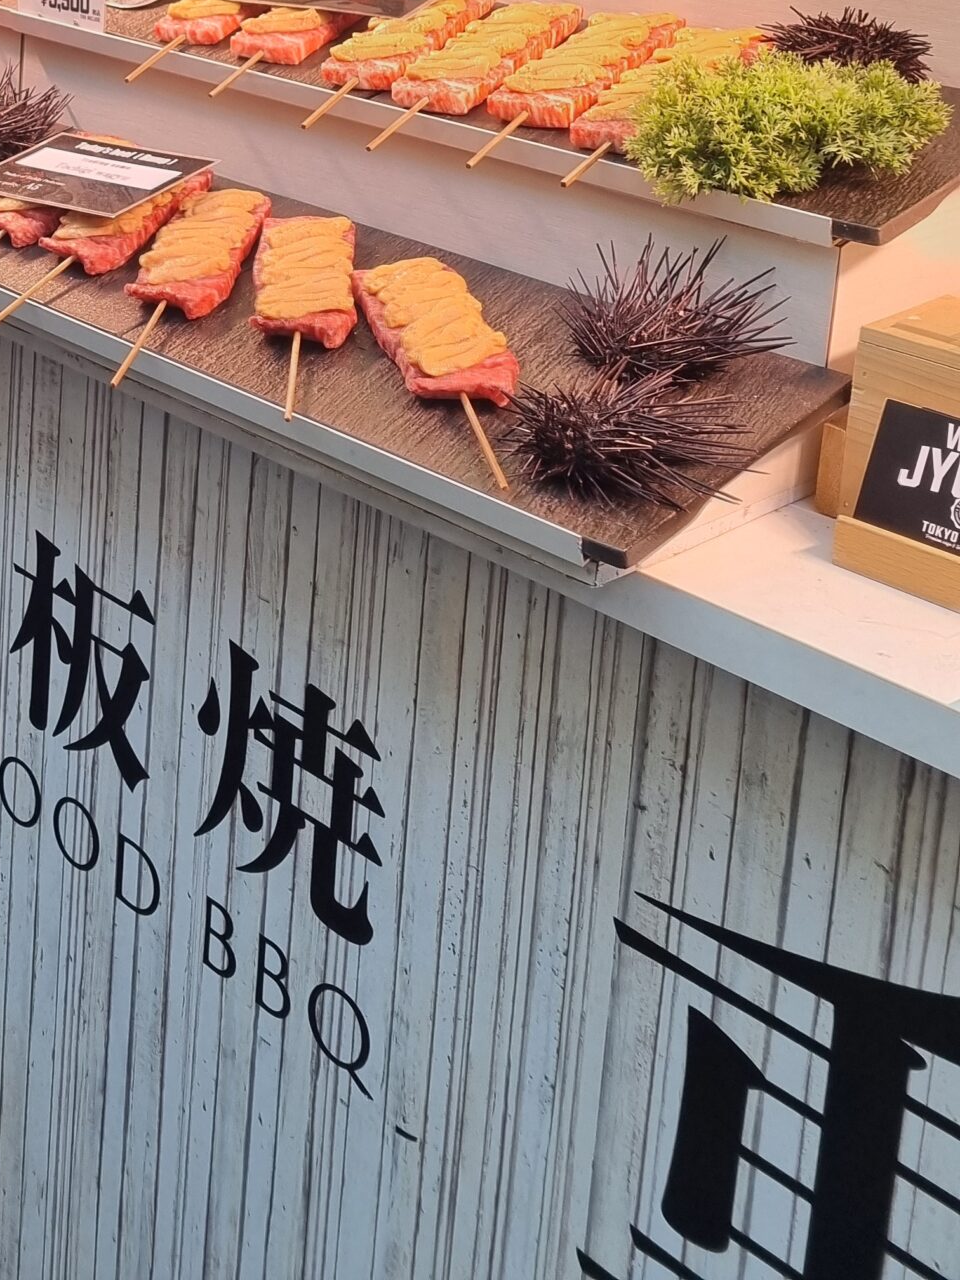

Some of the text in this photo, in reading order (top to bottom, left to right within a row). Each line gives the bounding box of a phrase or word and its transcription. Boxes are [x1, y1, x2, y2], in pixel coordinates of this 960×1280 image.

[897, 445, 960, 499] JY
[922, 520, 959, 543] TOKYO
[203, 894, 376, 1102] BBQ
